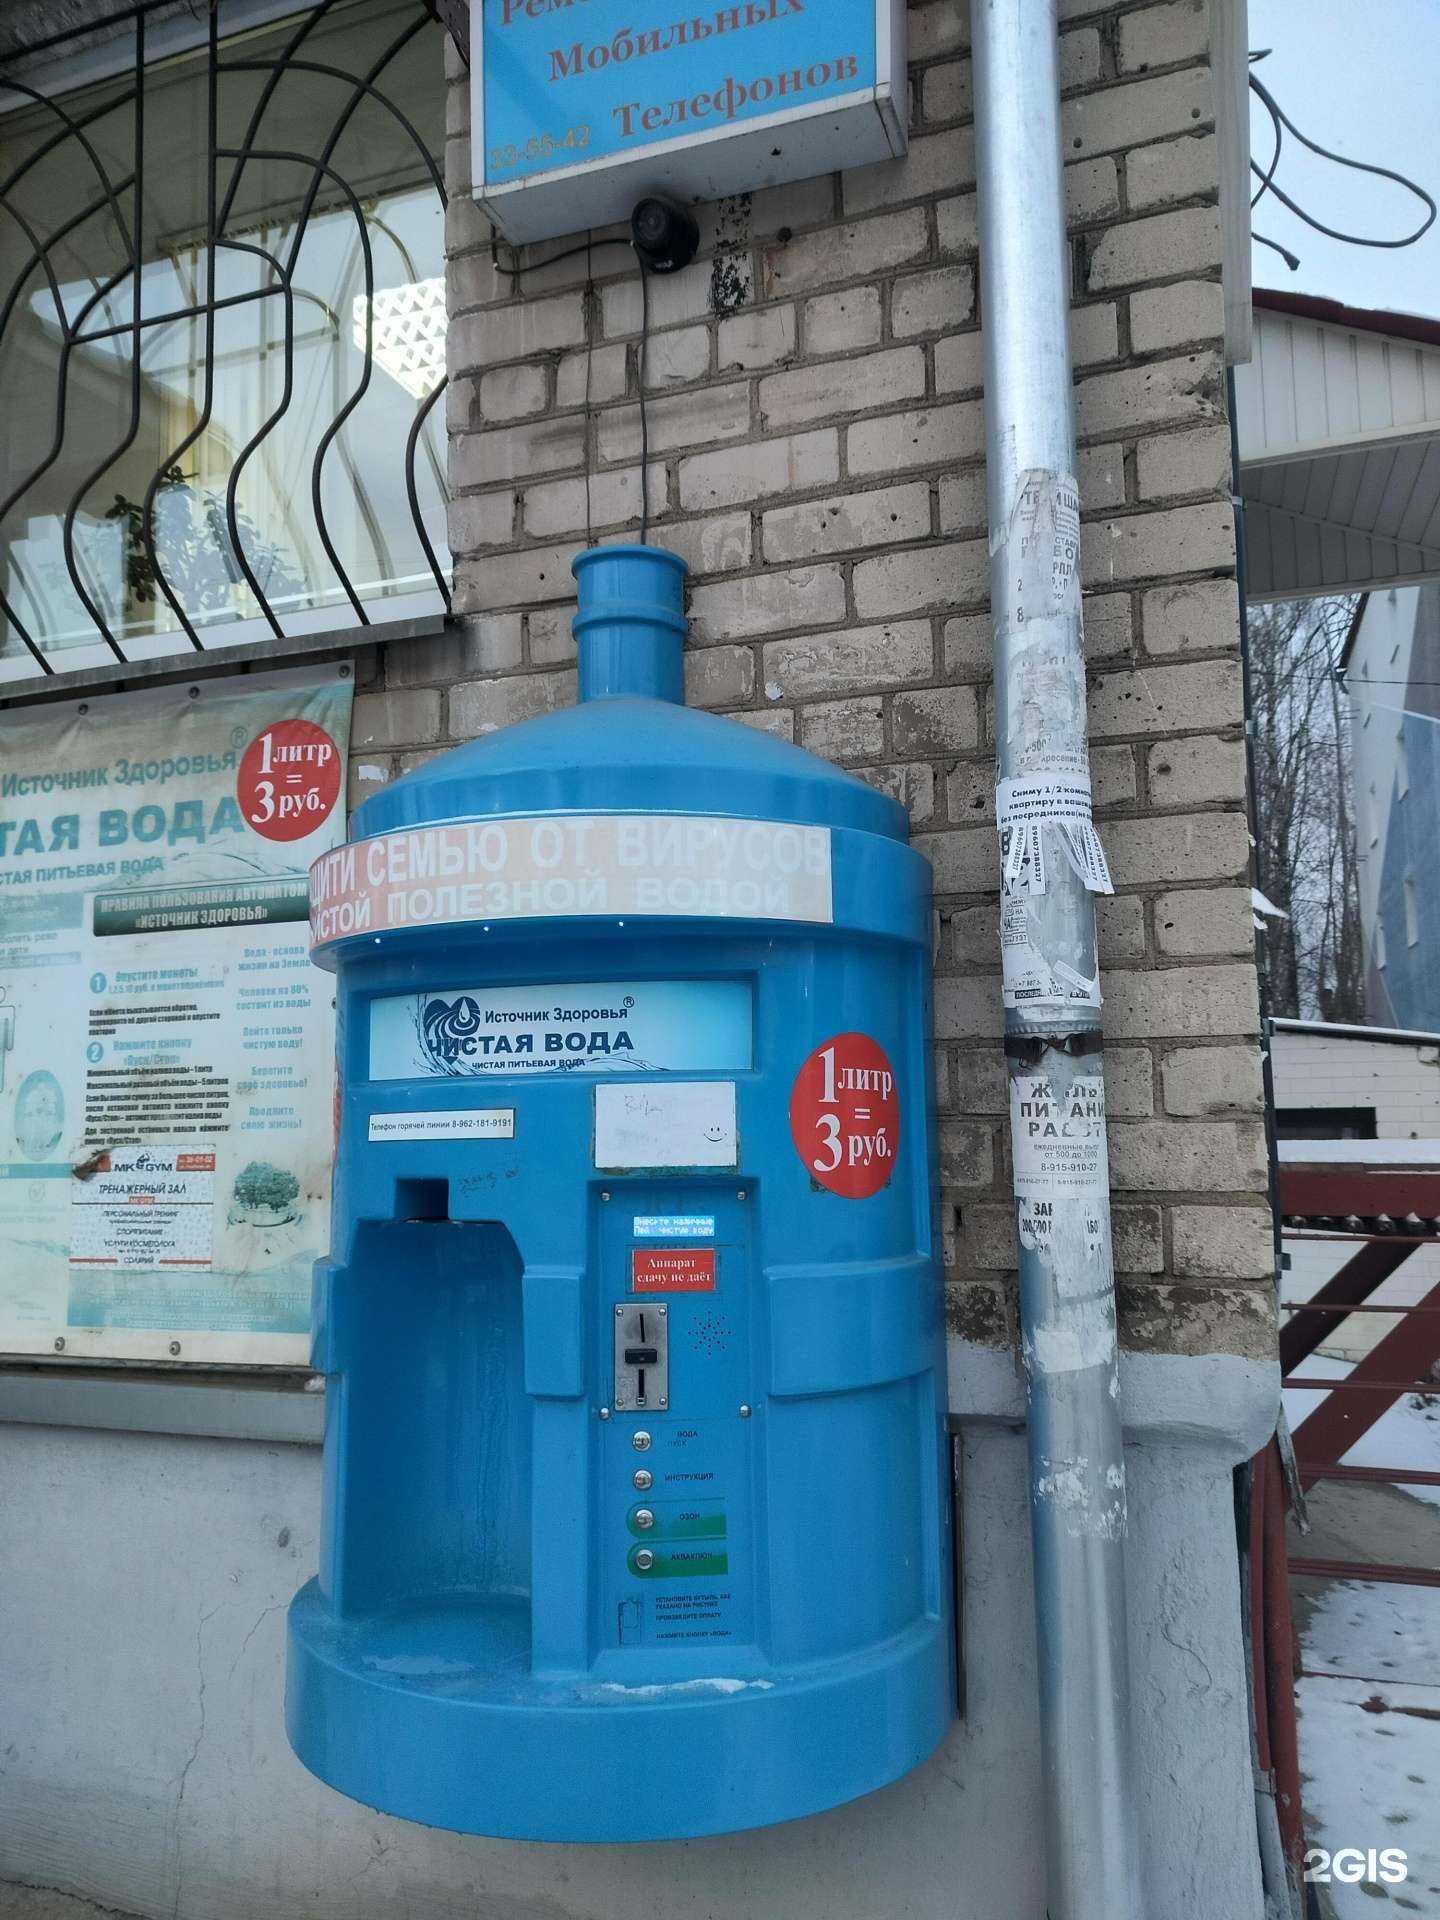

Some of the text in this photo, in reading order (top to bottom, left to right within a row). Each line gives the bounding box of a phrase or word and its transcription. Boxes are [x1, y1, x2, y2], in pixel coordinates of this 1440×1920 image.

[548, 0, 806, 82] Мобильных
[613, 54, 858, 138] Телефонов
[257, 733, 332, 774] 1 литр
[2, 767, 108, 797] Источник
[114, 751, 237, 786] Здоровья
[251, 780, 326, 823] 3 руб.
[1009, 798, 1055, 810] квартиру
[1012, 786, 1042, 798] Сниму
[99, 796, 246, 847] ВОДА
[366, 825, 509, 887] СЕМЬЮ
[530, 819, 595, 868] ОТ
[617, 820, 830, 877] ВИРУСОВ
[36, 862, 116, 882] ПИТЬЕВАЯ
[120, 856, 164, 874] ВОДА
[387, 868, 608, 924] ПОЛЕЗНОЙ
[635, 870, 790, 914] ВОДОЙ
[485, 1009, 549, 1024] Источник
[553, 1007, 628, 1022] Здоровья
[428, 1031, 635, 1057] ЧИСТАЯ ВОДА
[472, 1061, 505, 1069] ЧИСТАЯ
[508, 1059, 556, 1068] ПИТЬЕВАЯ
[818, 1047, 892, 1103] 1 литр
[371, 1122, 397, 1131] Телефон
[397, 1121, 425, 1132] горячей
[452, 1119, 511, 1128] 8-962-181-9191
[814, 1113, 892, 1172] 3 руб.
[145, 1163, 173, 1172] GYM
[99, 1182, 187, 1194] ТРЕНАЖЕРНЫЙ ЗАЛ
[648, 1259, 697, 1269] Аппарат
[637, 1272, 711, 1284] сдачу не даёт
[664, 1472, 714, 1482] ИНСТРУКЦИЯ
